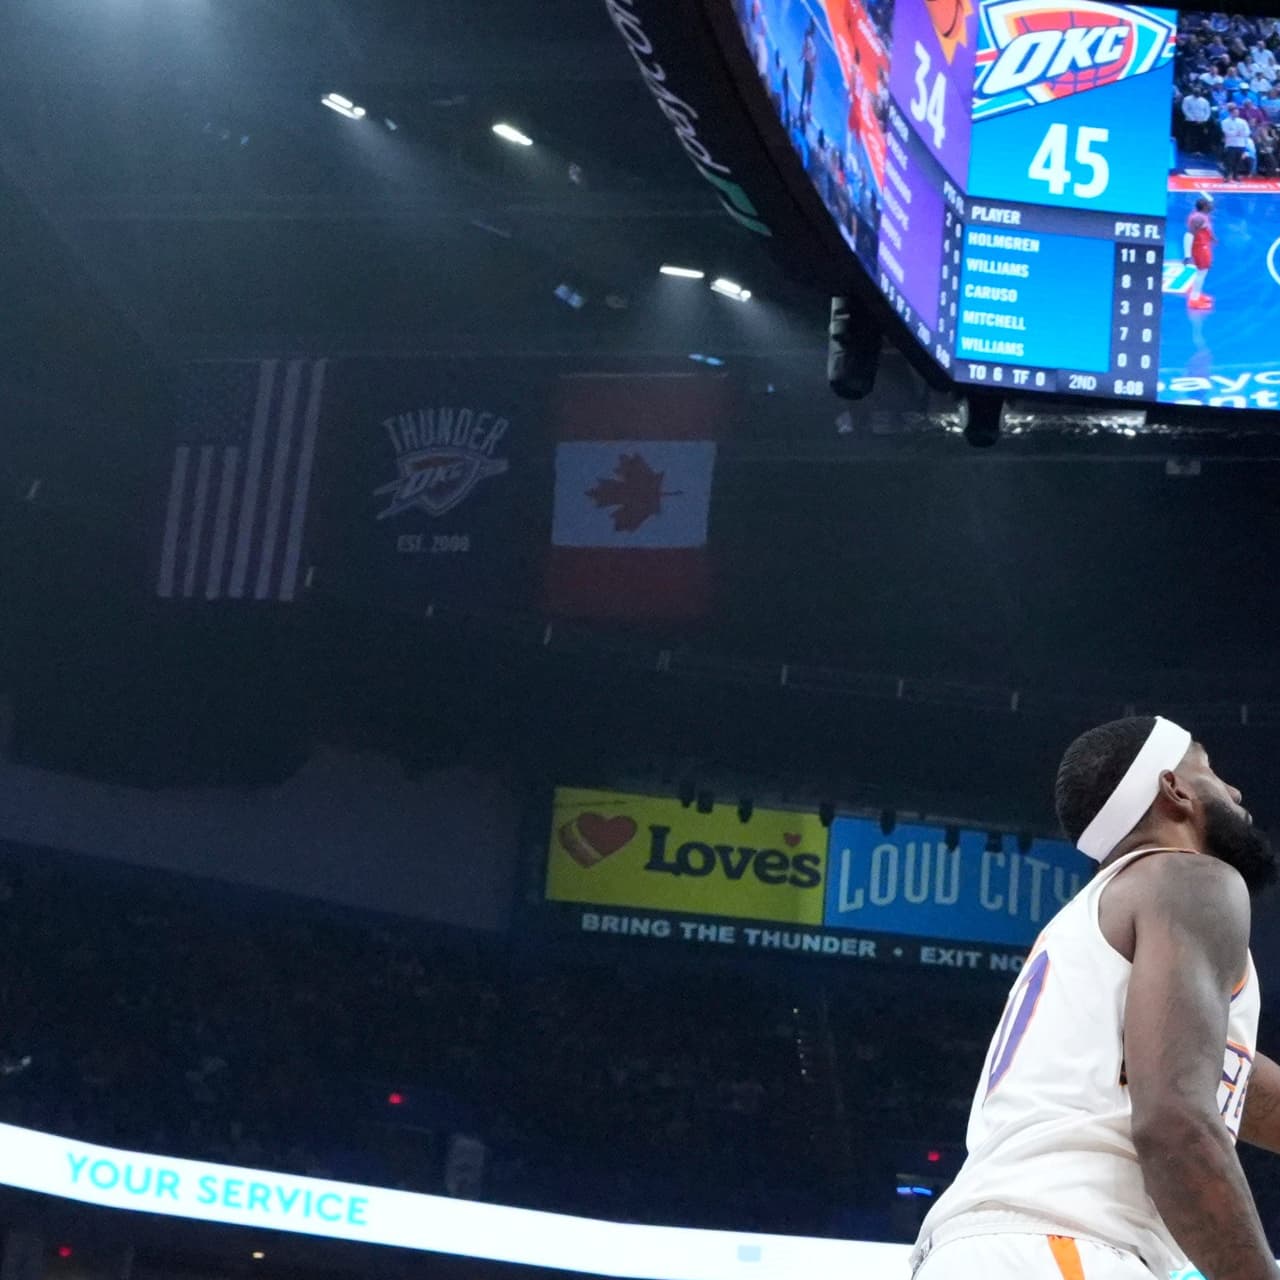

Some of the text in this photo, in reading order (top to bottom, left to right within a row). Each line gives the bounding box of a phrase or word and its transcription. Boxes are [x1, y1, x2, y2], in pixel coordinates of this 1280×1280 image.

[983, 24, 1129, 100] OKC
[910, 41, 948, 149] 34
[1029, 122, 1110, 199] 45
[971, 206, 1160, 239] PLAYER PTS FL
[968, 232, 1155, 264] HOLMGREN 11 0
[966, 258, 1153, 290] WILLIAMS 8 1
[965, 284, 1153, 316] CARUSO 3 0
[963, 310, 1152, 342] MITCHELL 7 0
[961, 336, 1150, 369] WILLIAMS 0 0
[968, 364, 1144, 395] TO 6 TF 0 2ND 8:08
[381, 407, 510, 457] THUNDER
[838, 840, 960, 913] LOUD
[581, 912, 1026, 973] BRING THE THUNDER EXIT NO
[66, 1151, 369, 1227] YOUR SERVICE
